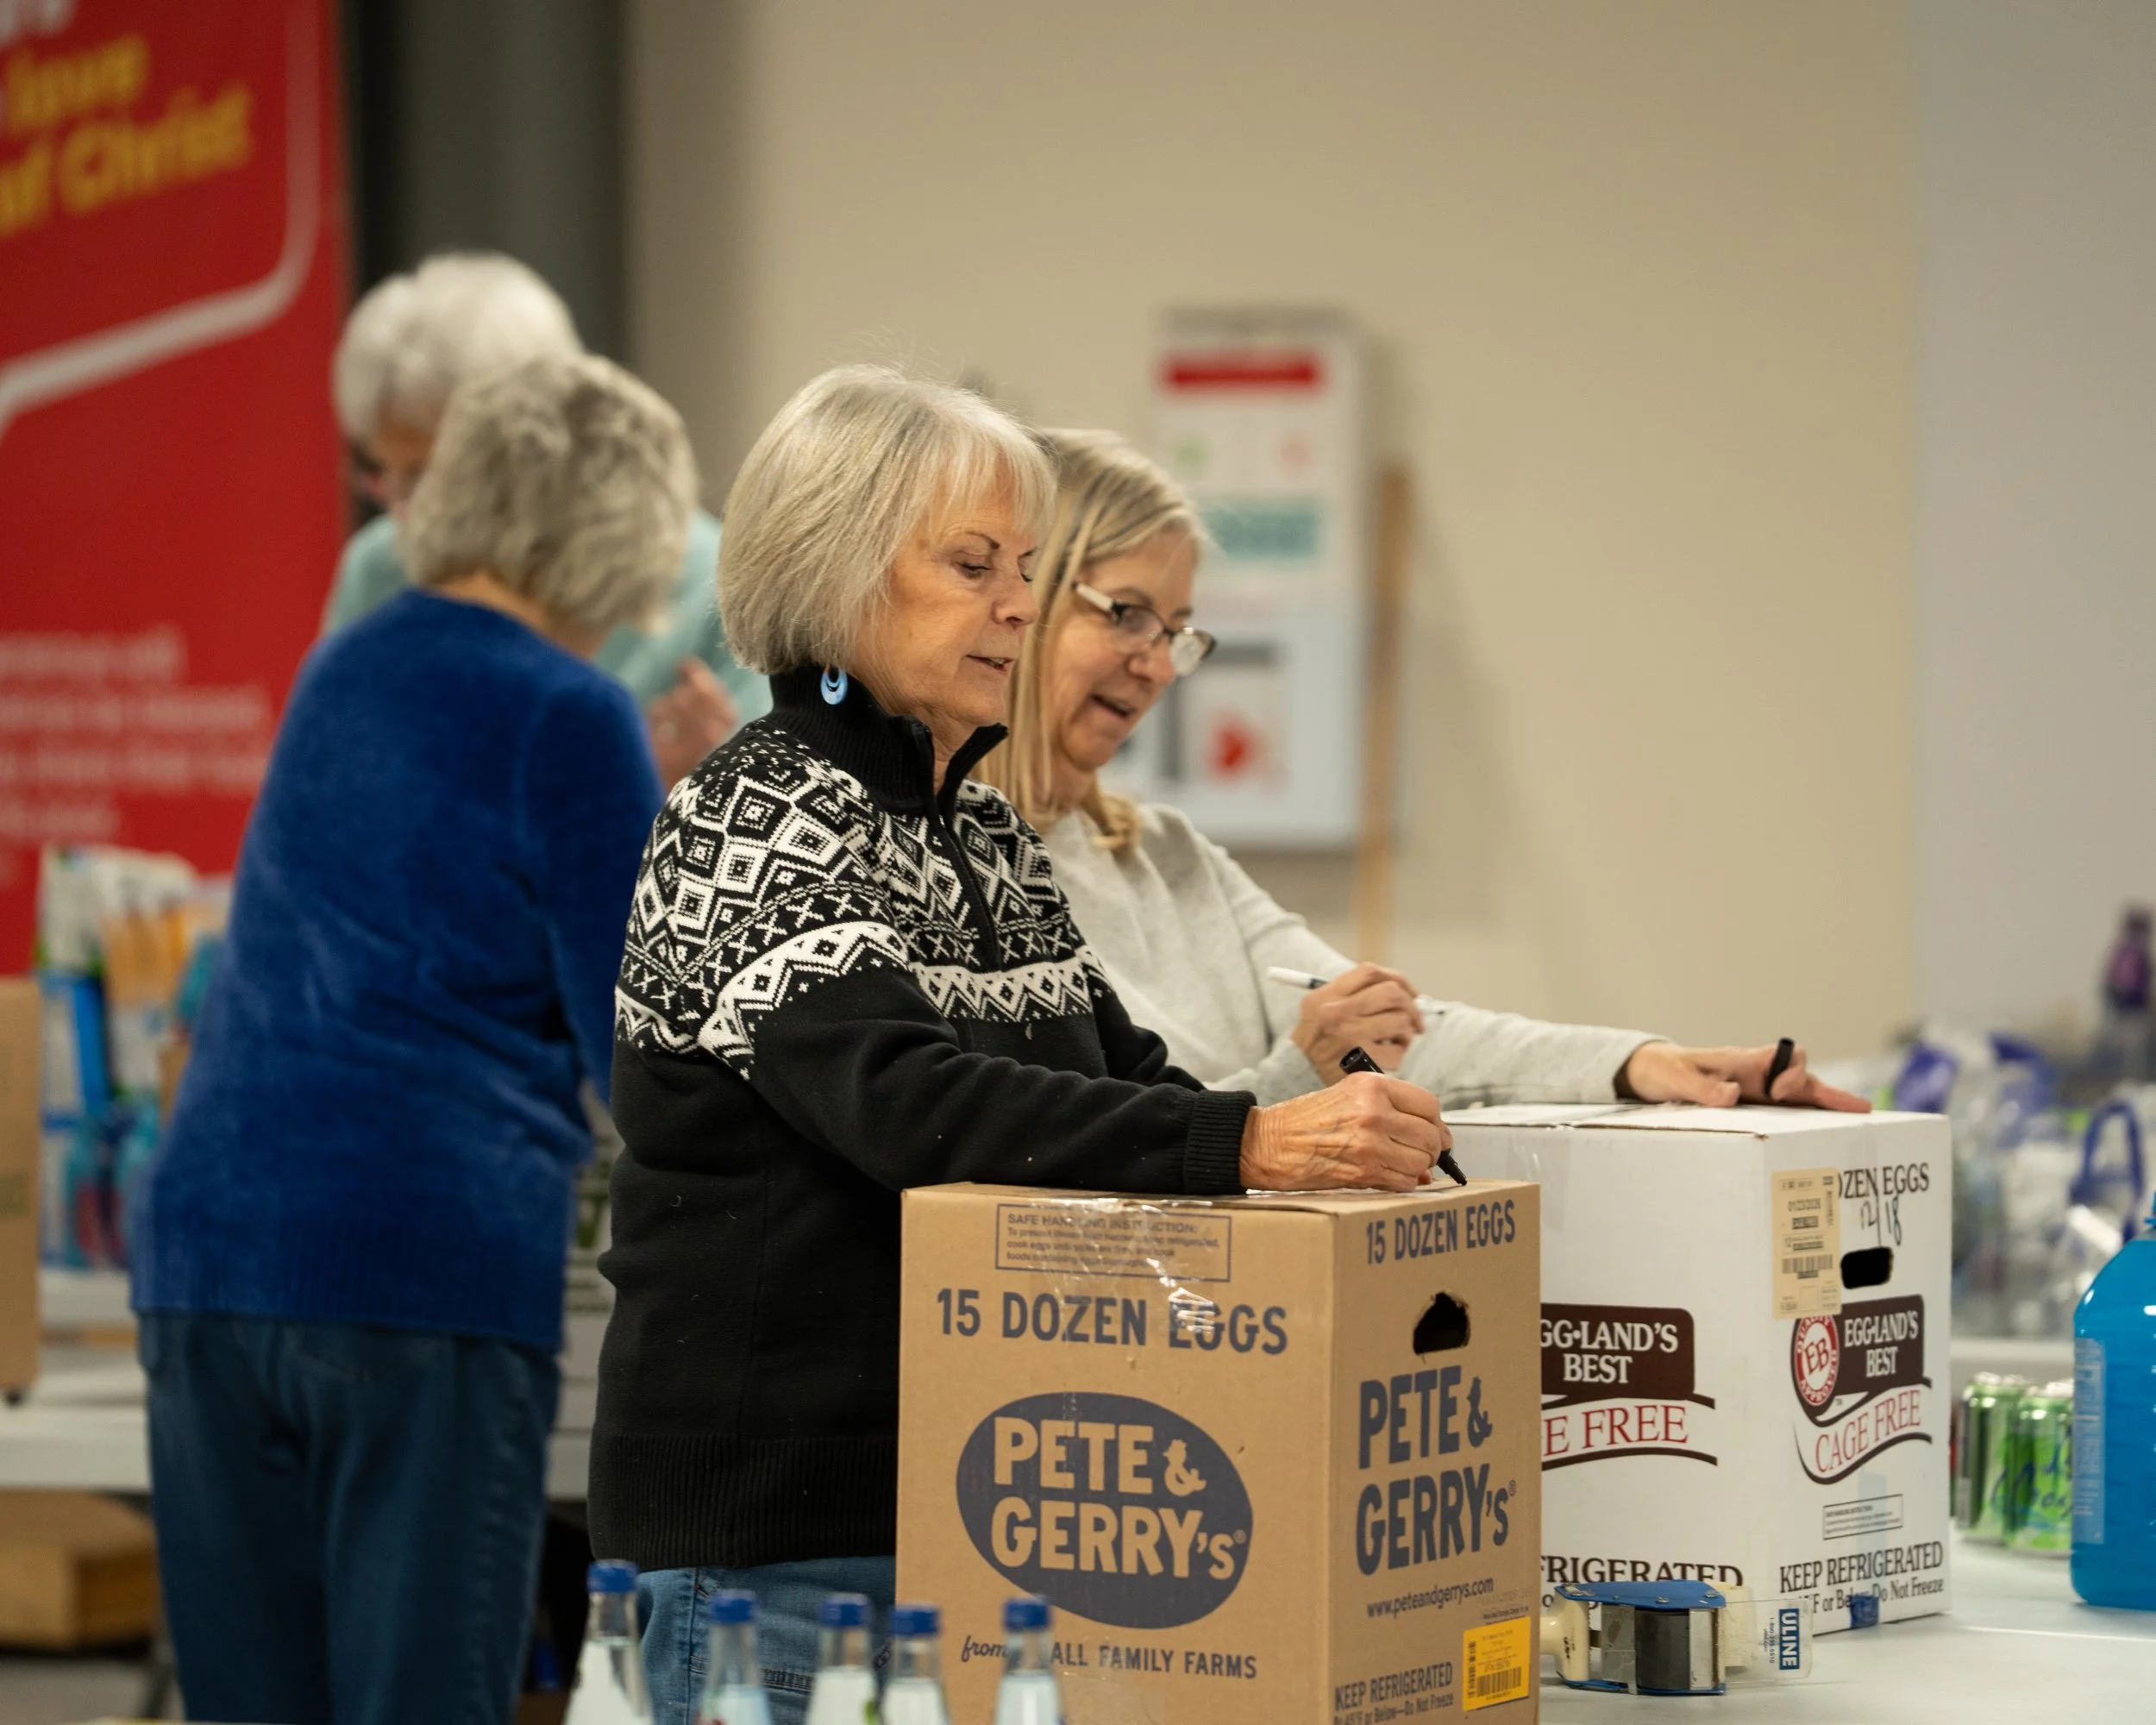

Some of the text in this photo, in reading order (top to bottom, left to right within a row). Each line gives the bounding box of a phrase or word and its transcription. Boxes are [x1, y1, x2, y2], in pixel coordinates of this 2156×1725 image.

[1838, 1162, 1929, 1199] ZEN EGGS
[1007, 1214, 1039, 1225] SAFE
[1043, 1215, 1106, 1229] HANDING
[1367, 1200, 1515, 1264] 15 DOZEN EGGS
[937, 1289, 1288, 1356] 15 DOZEN EGGS
[1563, 1353, 1633, 1384] BEST
[1804, 1338, 1830, 1376] EB
[1865, 1346, 1899, 1378] BEST
[1358, 1364, 1462, 1470] PETE
[1581, 1404, 1689, 1450] FREE
[1814, 1389, 1921, 1473] CAGE FREE
[993, 1416, 1155, 1495] PETE
[1780, 1540, 1944, 1594] KEEP REFRIGERATED
[1890, 1580, 1908, 1602] Not
[1911, 1576, 1945, 1597] Freeze
[1367, 1578, 1494, 1619] www.peteandgerrys.com
[961, 1635, 1257, 1679] from ALL FAMILY FARMS
[1781, 1611, 1798, 1666] ULINE
[1335, 1661, 1453, 1711] KEEP REFRIGERATED
